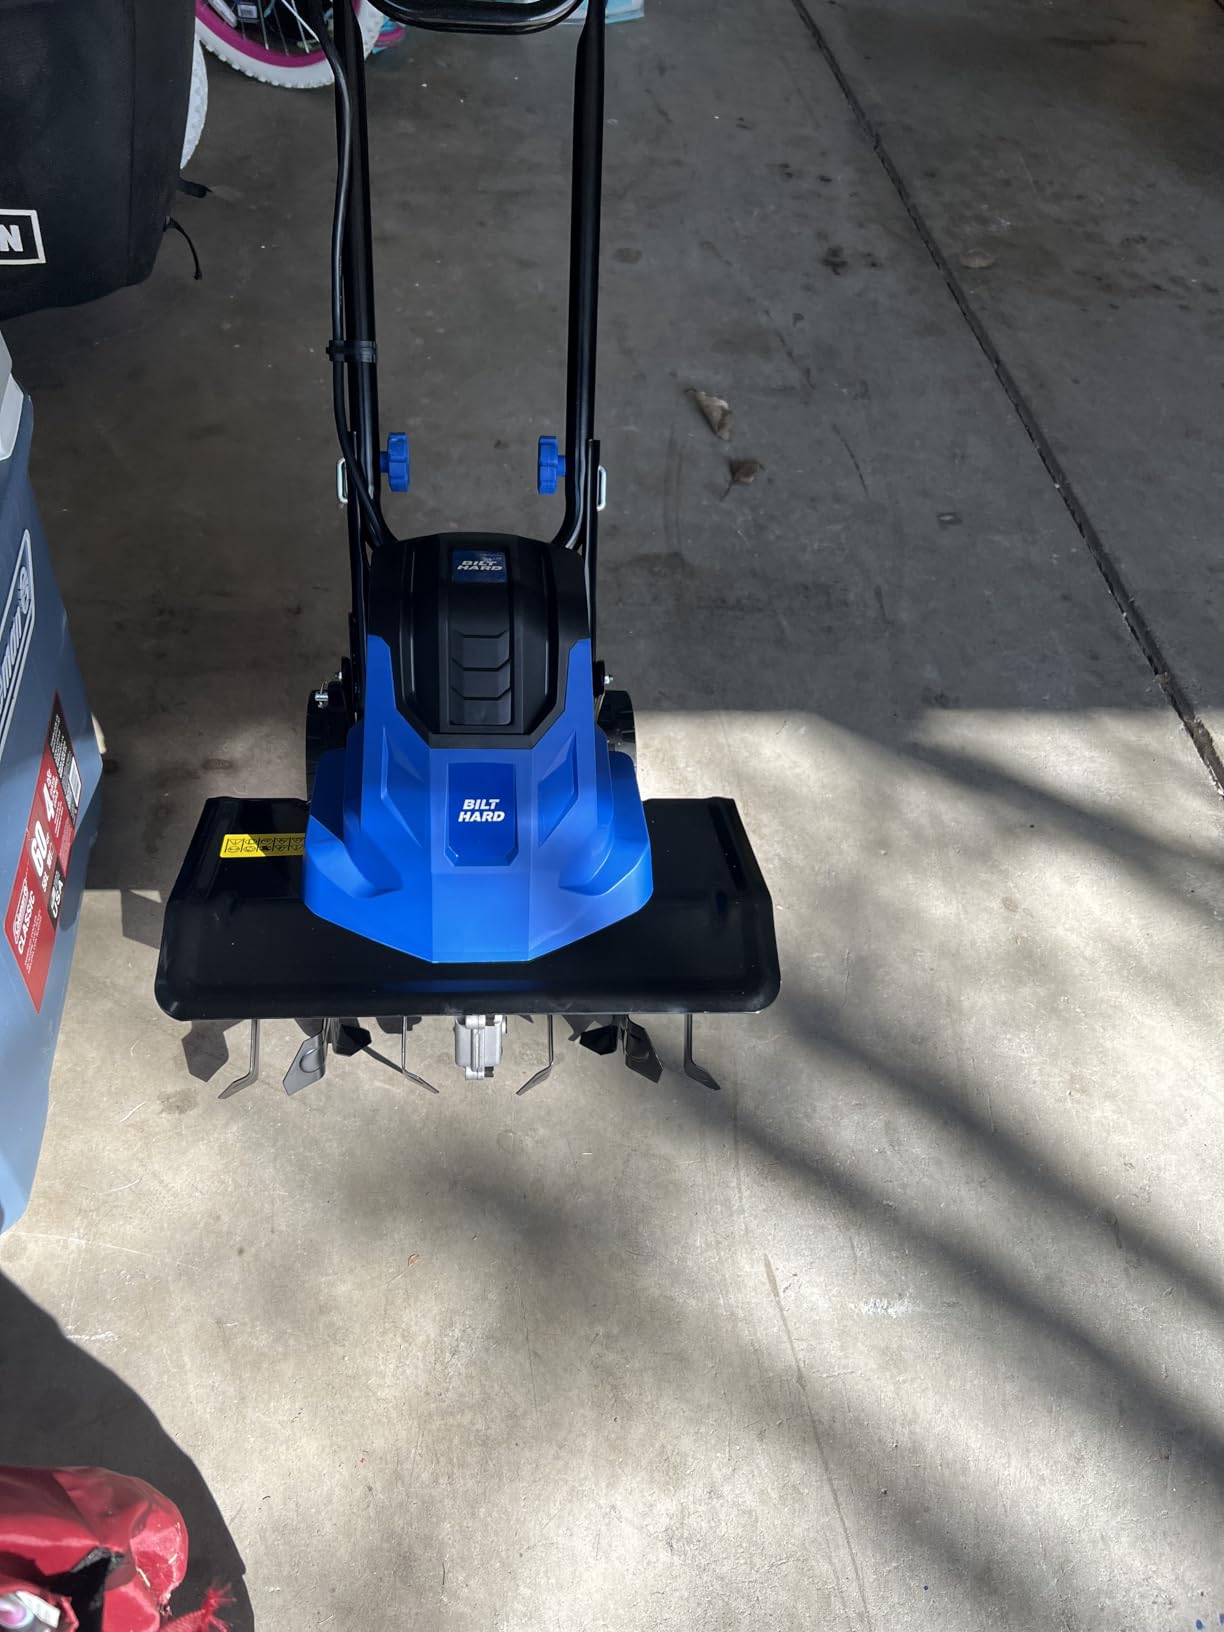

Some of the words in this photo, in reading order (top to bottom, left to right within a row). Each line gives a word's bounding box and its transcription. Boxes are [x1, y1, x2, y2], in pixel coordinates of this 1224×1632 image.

[43, 782, 54, 822] 4
[458, 811, 505, 822] HARD
[462, 799, 500, 810] BILT
[31, 820, 47, 877] 60
[52, 880, 63, 918] USA
[17, 890, 35, 954] CLASSIC
